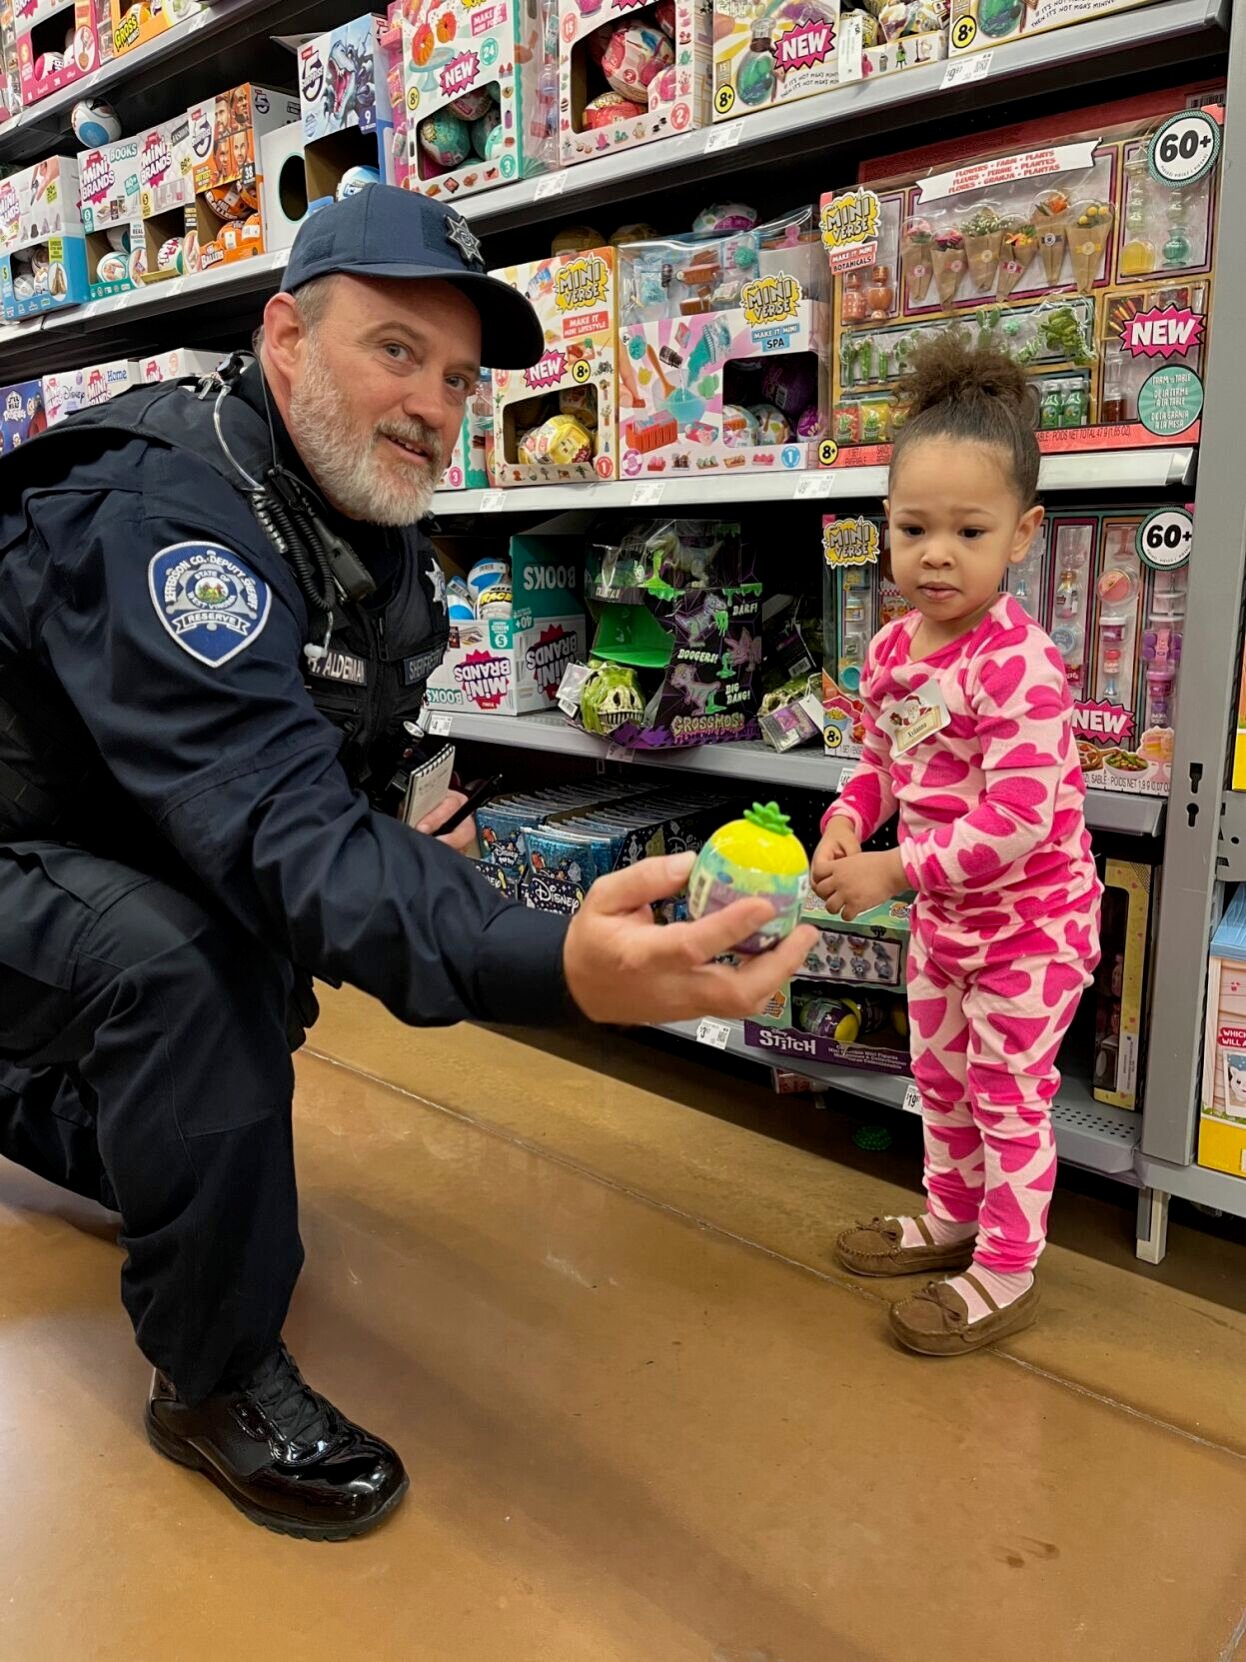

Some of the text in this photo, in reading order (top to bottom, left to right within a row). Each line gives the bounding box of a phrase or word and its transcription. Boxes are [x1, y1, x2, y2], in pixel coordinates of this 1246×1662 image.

[1060, 4, 1072, 12] NOT
[114, 14, 138, 50] GROSS
[782, 28, 828, 63] NEW
[443, 57, 475, 85] NEW
[364, 110, 372, 124] 9
[675, 108, 686, 124] 2
[110, 143, 138, 163] BOOKS
[1159, 129, 1212, 163] 60+
[141, 152, 172, 186] BRANDS
[503, 160, 512, 173] 3
[955, 164, 989, 178] FLOWERS
[1025, 150, 1056, 161] PLANTS
[1020, 157, 1057, 170] PLANTES
[1023, 163, 1061, 177] PLANTAS
[81, 172, 116, 202] BRANDS
[826, 198, 871, 232] MINI
[832, 216, 869, 243] VERSE
[834, 255, 872, 272] BOTANICALS
[559, 261, 601, 295] MINI
[565, 283, 601, 306] VERSE
[749, 279, 793, 310] MINI
[754, 300, 792, 320] VERSE
[754, 330, 772, 339] MAKE
[1131, 318, 1197, 346] NEW
[766, 337, 785, 349] SPA
[106, 368, 129, 383] Home
[529, 357, 561, 382] NEW
[1152, 375, 1169, 385] FARM
[1175, 373, 1192, 383] TABLE
[828, 525, 871, 549] MINI
[1146, 524, 1193, 549] 60+
[834, 543, 869, 559] VERSE
[194, 570, 218, 580] STATE
[209, 555, 246, 578] DEPUTY
[522, 564, 577, 592] BOOKS
[187, 612, 237, 625] RESERVE
[732, 602, 759, 617] BARF!
[526, 633, 578, 670] BRANDS
[453, 656, 512, 683] BRANDS
[426, 687, 464, 706] BOOKS
[725, 682, 740, 695] BIG
[726, 689, 751, 705] BANG!
[1072, 708, 1129, 736] NEW
[1111, 776, 1127, 788] POIDS
[1127, 779, 1137, 789] NET
[1221, 1038, 1241, 1047] WILL
